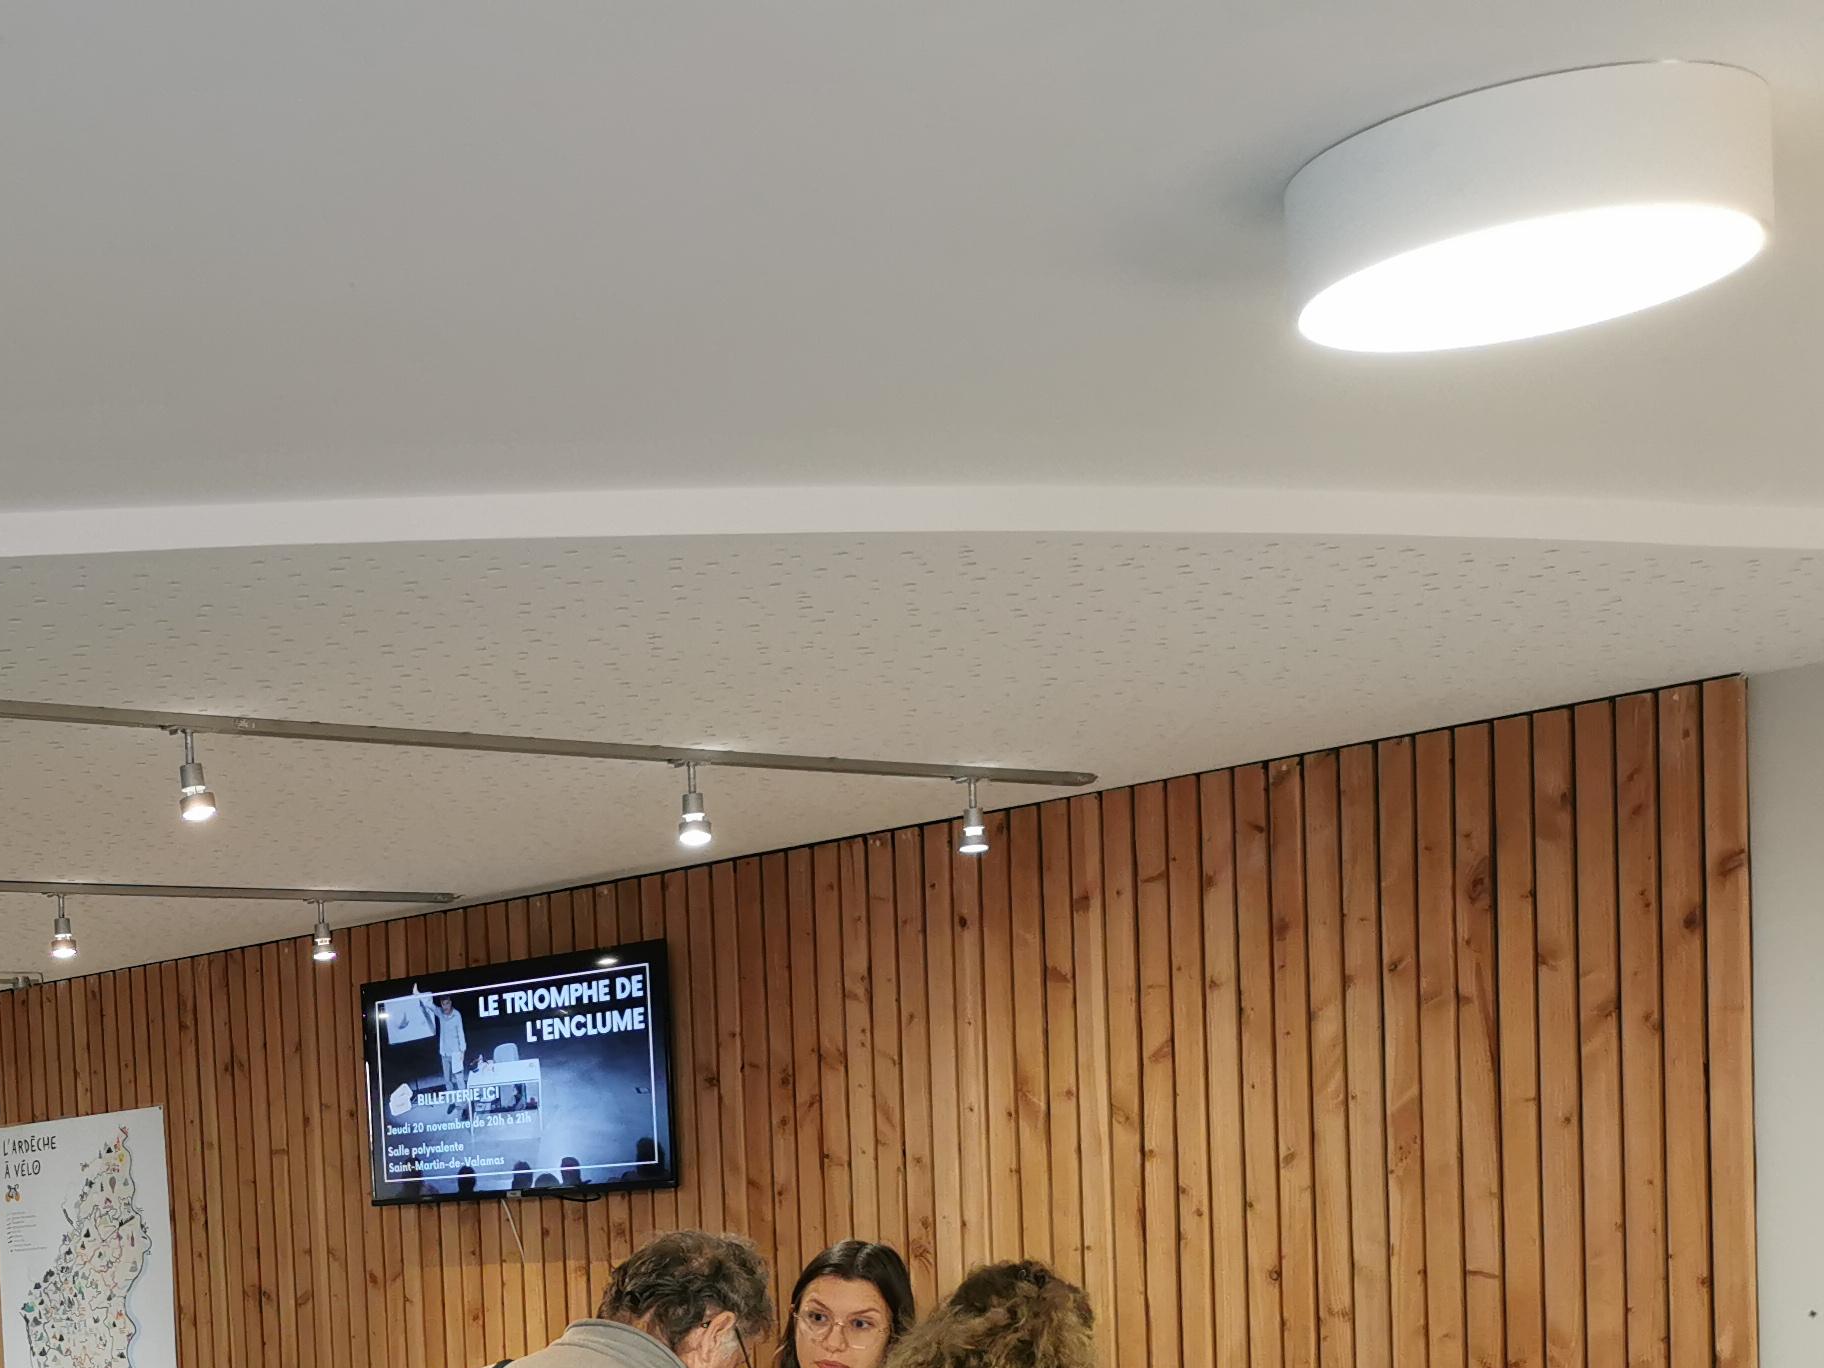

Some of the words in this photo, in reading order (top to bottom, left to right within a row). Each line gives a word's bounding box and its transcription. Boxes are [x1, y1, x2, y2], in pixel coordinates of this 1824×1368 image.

[478, 993, 499, 1018] LE
[504, 978, 611, 1013] TRIOMPHE
[616, 974, 643, 998] DE
[526, 1007, 646, 1043] L'ENCLUME
[417, 1087, 481, 1107] BILLETTERIE
[483, 1085, 500, 1101] ICI
[386, 1122, 410, 1136] Jeudi
[412, 1122, 425, 1134] 20
[426, 1117, 470, 1132] novembre
[473, 1116, 485, 1128] de
[486, 1115, 505, 1127] 20h
[506, 1114, 514, 1126] à
[515, 1113, 532, 1125] 21h
[387, 1145, 410, 1157] Salle
[412, 1142, 464, 1157] polyvalente
[14, 1159, 41, 1178] VÉLO
[388, 1155, 504, 1174] Saint-Martin-de-Valamas
